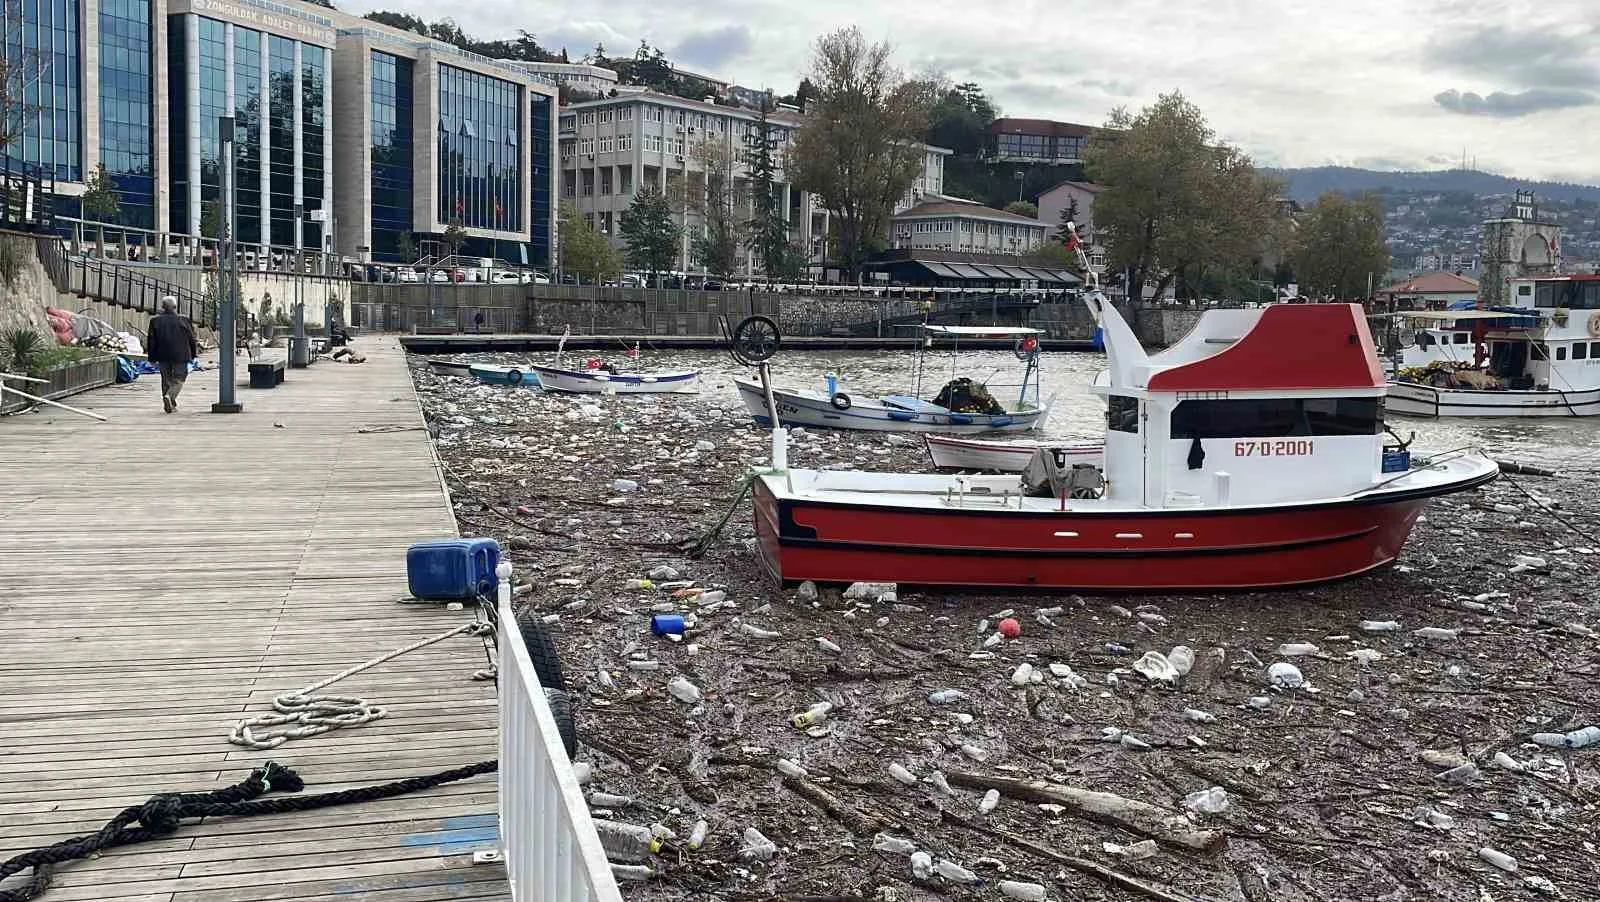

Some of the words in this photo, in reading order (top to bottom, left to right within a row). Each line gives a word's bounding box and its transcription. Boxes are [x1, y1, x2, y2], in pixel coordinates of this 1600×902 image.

[206, 1, 257, 22] ZONGULDAK
[263, 14, 293, 31] ADALET
[1516, 205, 1533, 219] TTK
